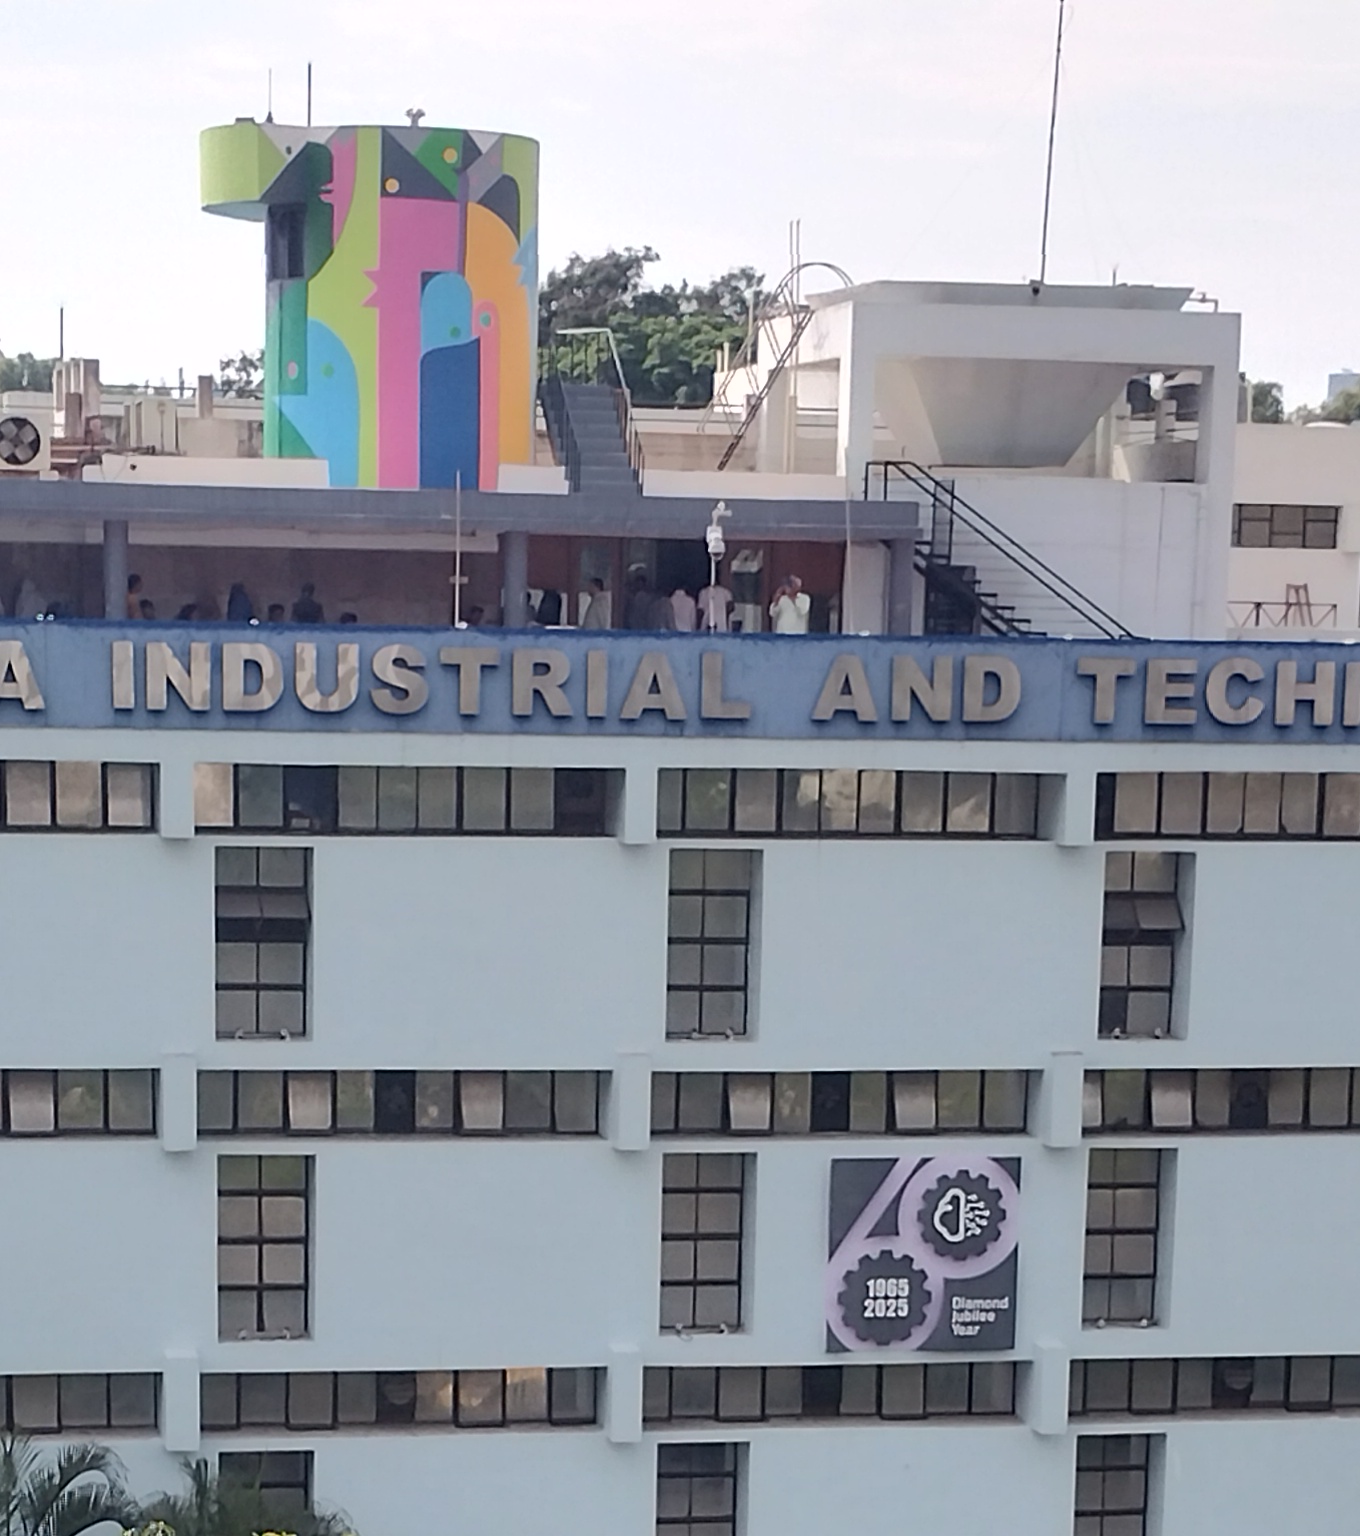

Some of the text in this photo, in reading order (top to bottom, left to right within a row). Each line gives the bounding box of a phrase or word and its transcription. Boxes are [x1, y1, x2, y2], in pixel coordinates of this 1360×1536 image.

[110, 639, 752, 721] INDUSTRIAL
[810, 653, 1023, 724] AND
[866, 1278, 910, 1298] 1965
[863, 1299, 910, 1318] 2025
[952, 1296, 1009, 1310] Diamond
[952, 1323, 980, 1336] Year
